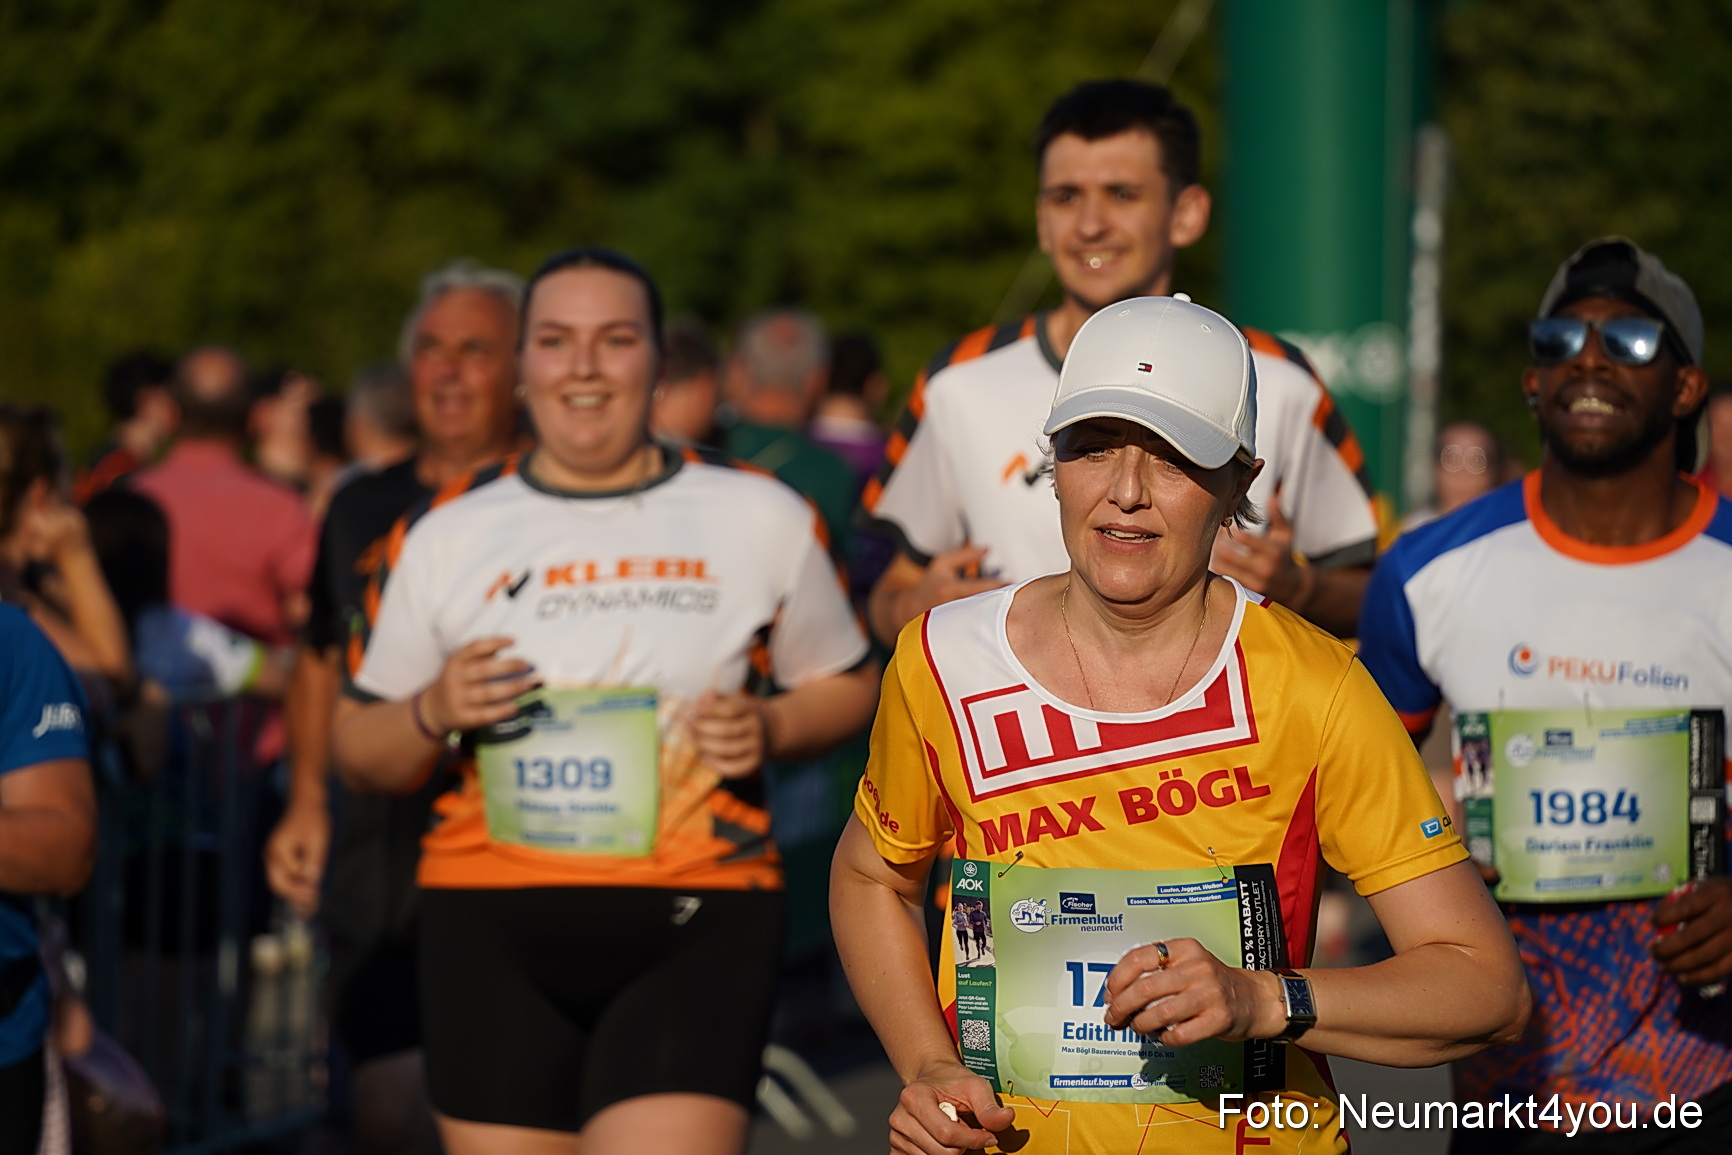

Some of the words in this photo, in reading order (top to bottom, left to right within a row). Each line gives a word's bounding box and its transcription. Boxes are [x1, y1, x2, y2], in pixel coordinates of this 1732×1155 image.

[545, 557, 719, 586] KLEBL
[537, 587, 719, 618] DYNAMICS
[1548, 656, 1688, 690] PEKUFolien
[514, 758, 612, 790] 1309
[978, 796, 1106, 856] MAX
[1118, 765, 1271, 826] BÖGL
[1529, 788, 1641, 825] 1984
[956, 878, 984, 892] AOK
[1239, 881, 1253, 938] RABATT
[1252, 881, 1264, 922] OUTLET
[1051, 914, 1123, 925] Firmenlauf
[1245, 940, 1254, 950] %
[1257, 923, 1267, 970] FACTORY
[1245, 953, 1255, 971] 20
[1063, 1022, 1115, 1042] Edith
[1076, 1047, 1090, 1055] Bögl
[1091, 1048, 1126, 1056] Bauservice
[1053, 1077, 1128, 1088] firmenlauf.bayern
